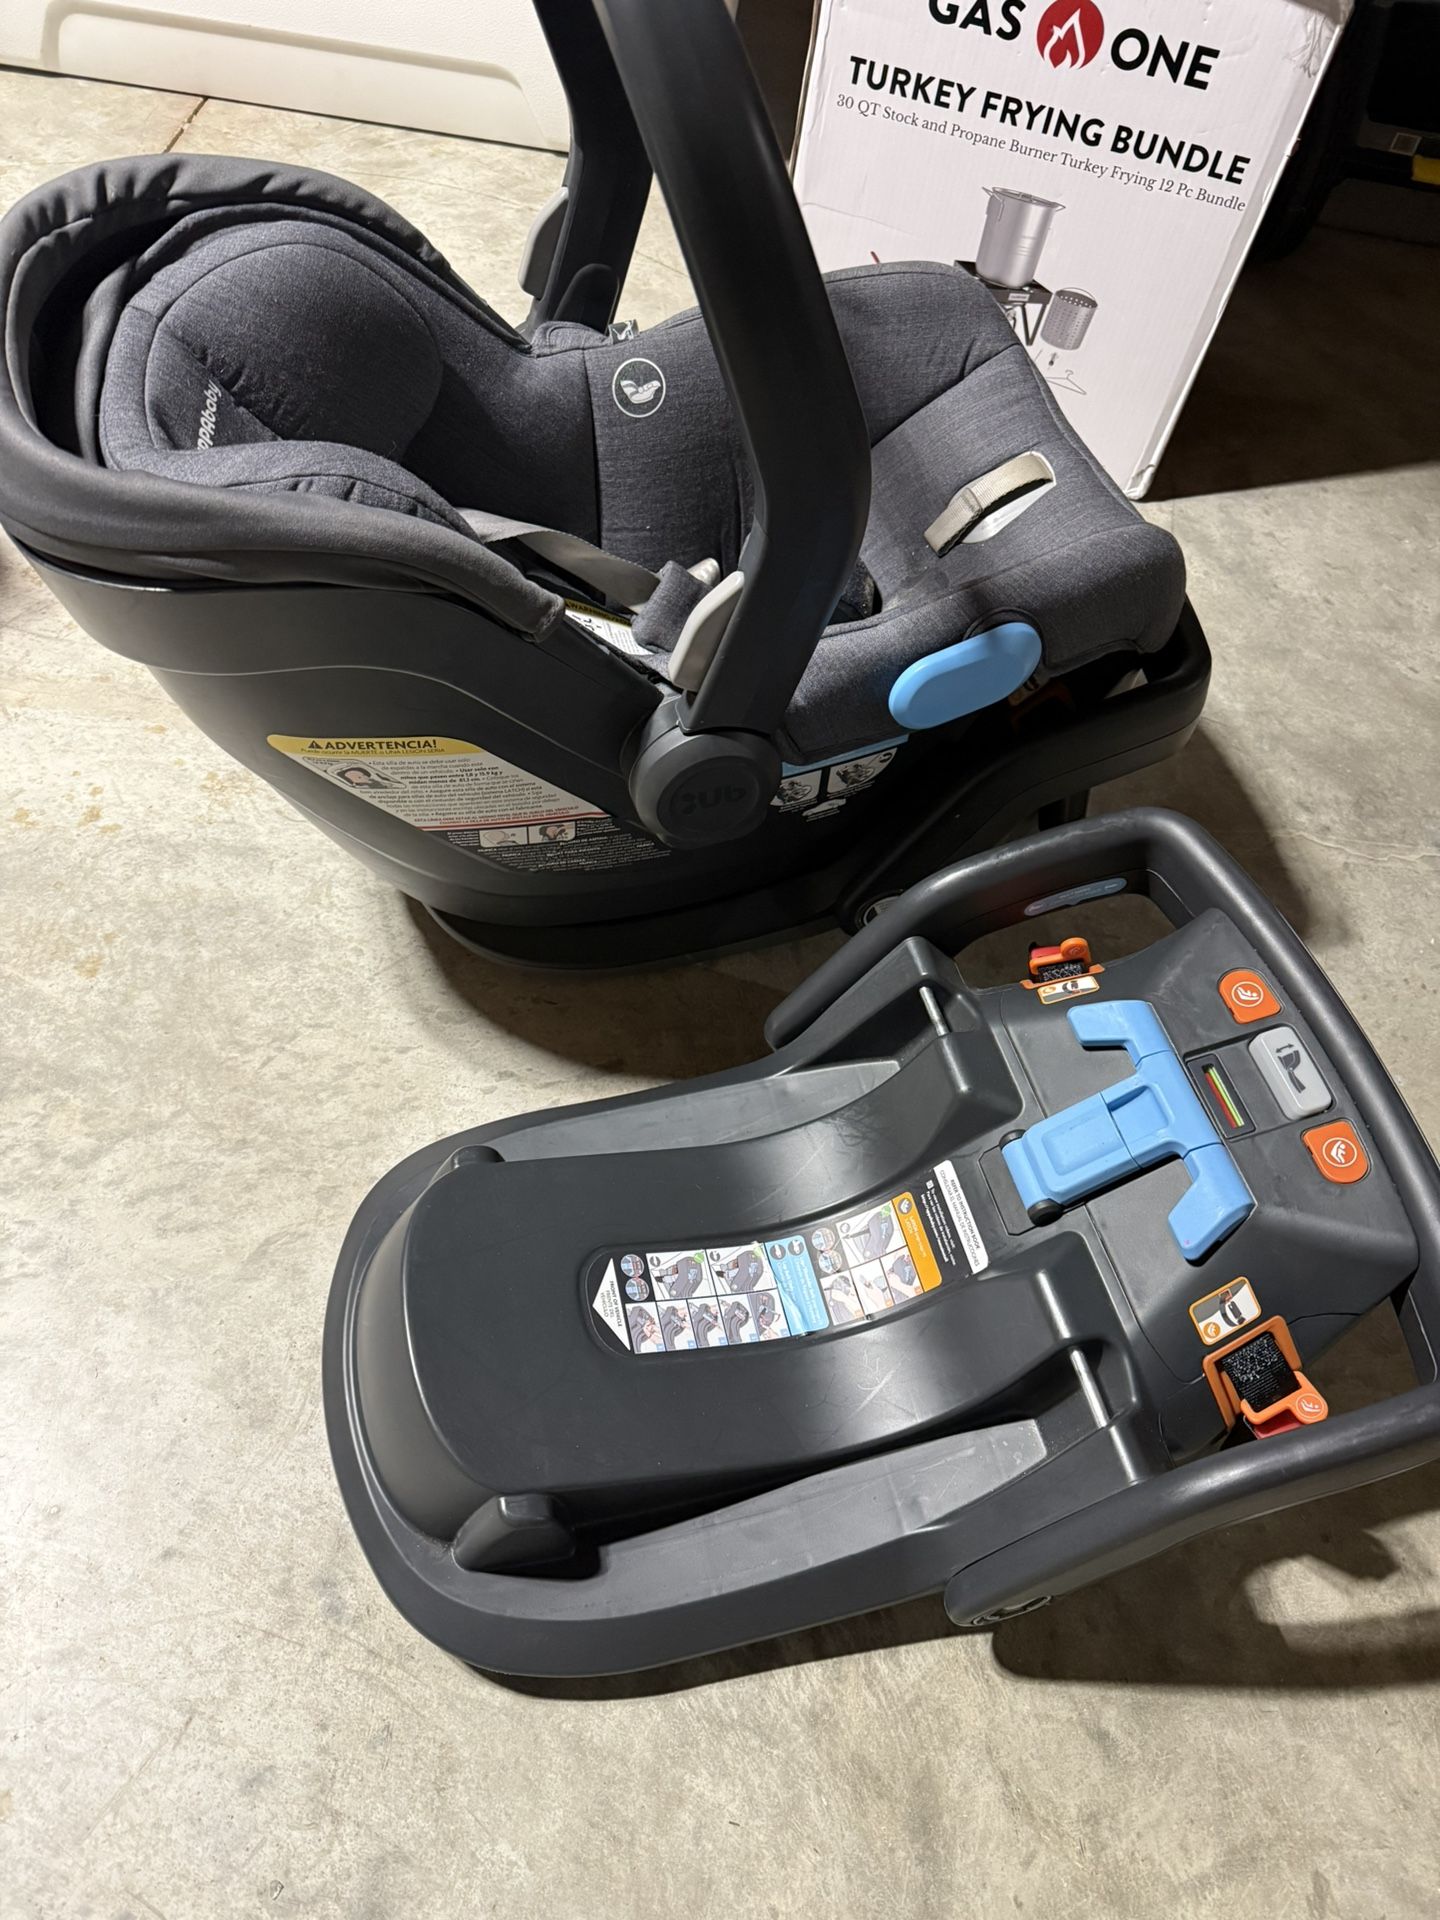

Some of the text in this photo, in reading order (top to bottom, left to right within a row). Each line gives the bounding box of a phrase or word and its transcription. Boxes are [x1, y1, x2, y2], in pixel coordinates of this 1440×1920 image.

[928, 0, 1026, 41] GAS
[1111, 28, 1220, 90] ONE
[850, 55, 1251, 185] TURKEY FRYING BUNDLE
[837, 94, 1246, 212] 30 QT Stock and Propane Burner Turkey Frying 12 Pc Bundle
[196, 379, 222, 450] PPAbaby
[325, 739, 437, 750] ADVERTENCIA!
[958, 1200, 974, 1234] INSTRUCTION
[614, 1306, 622, 1326] VEHICLE
